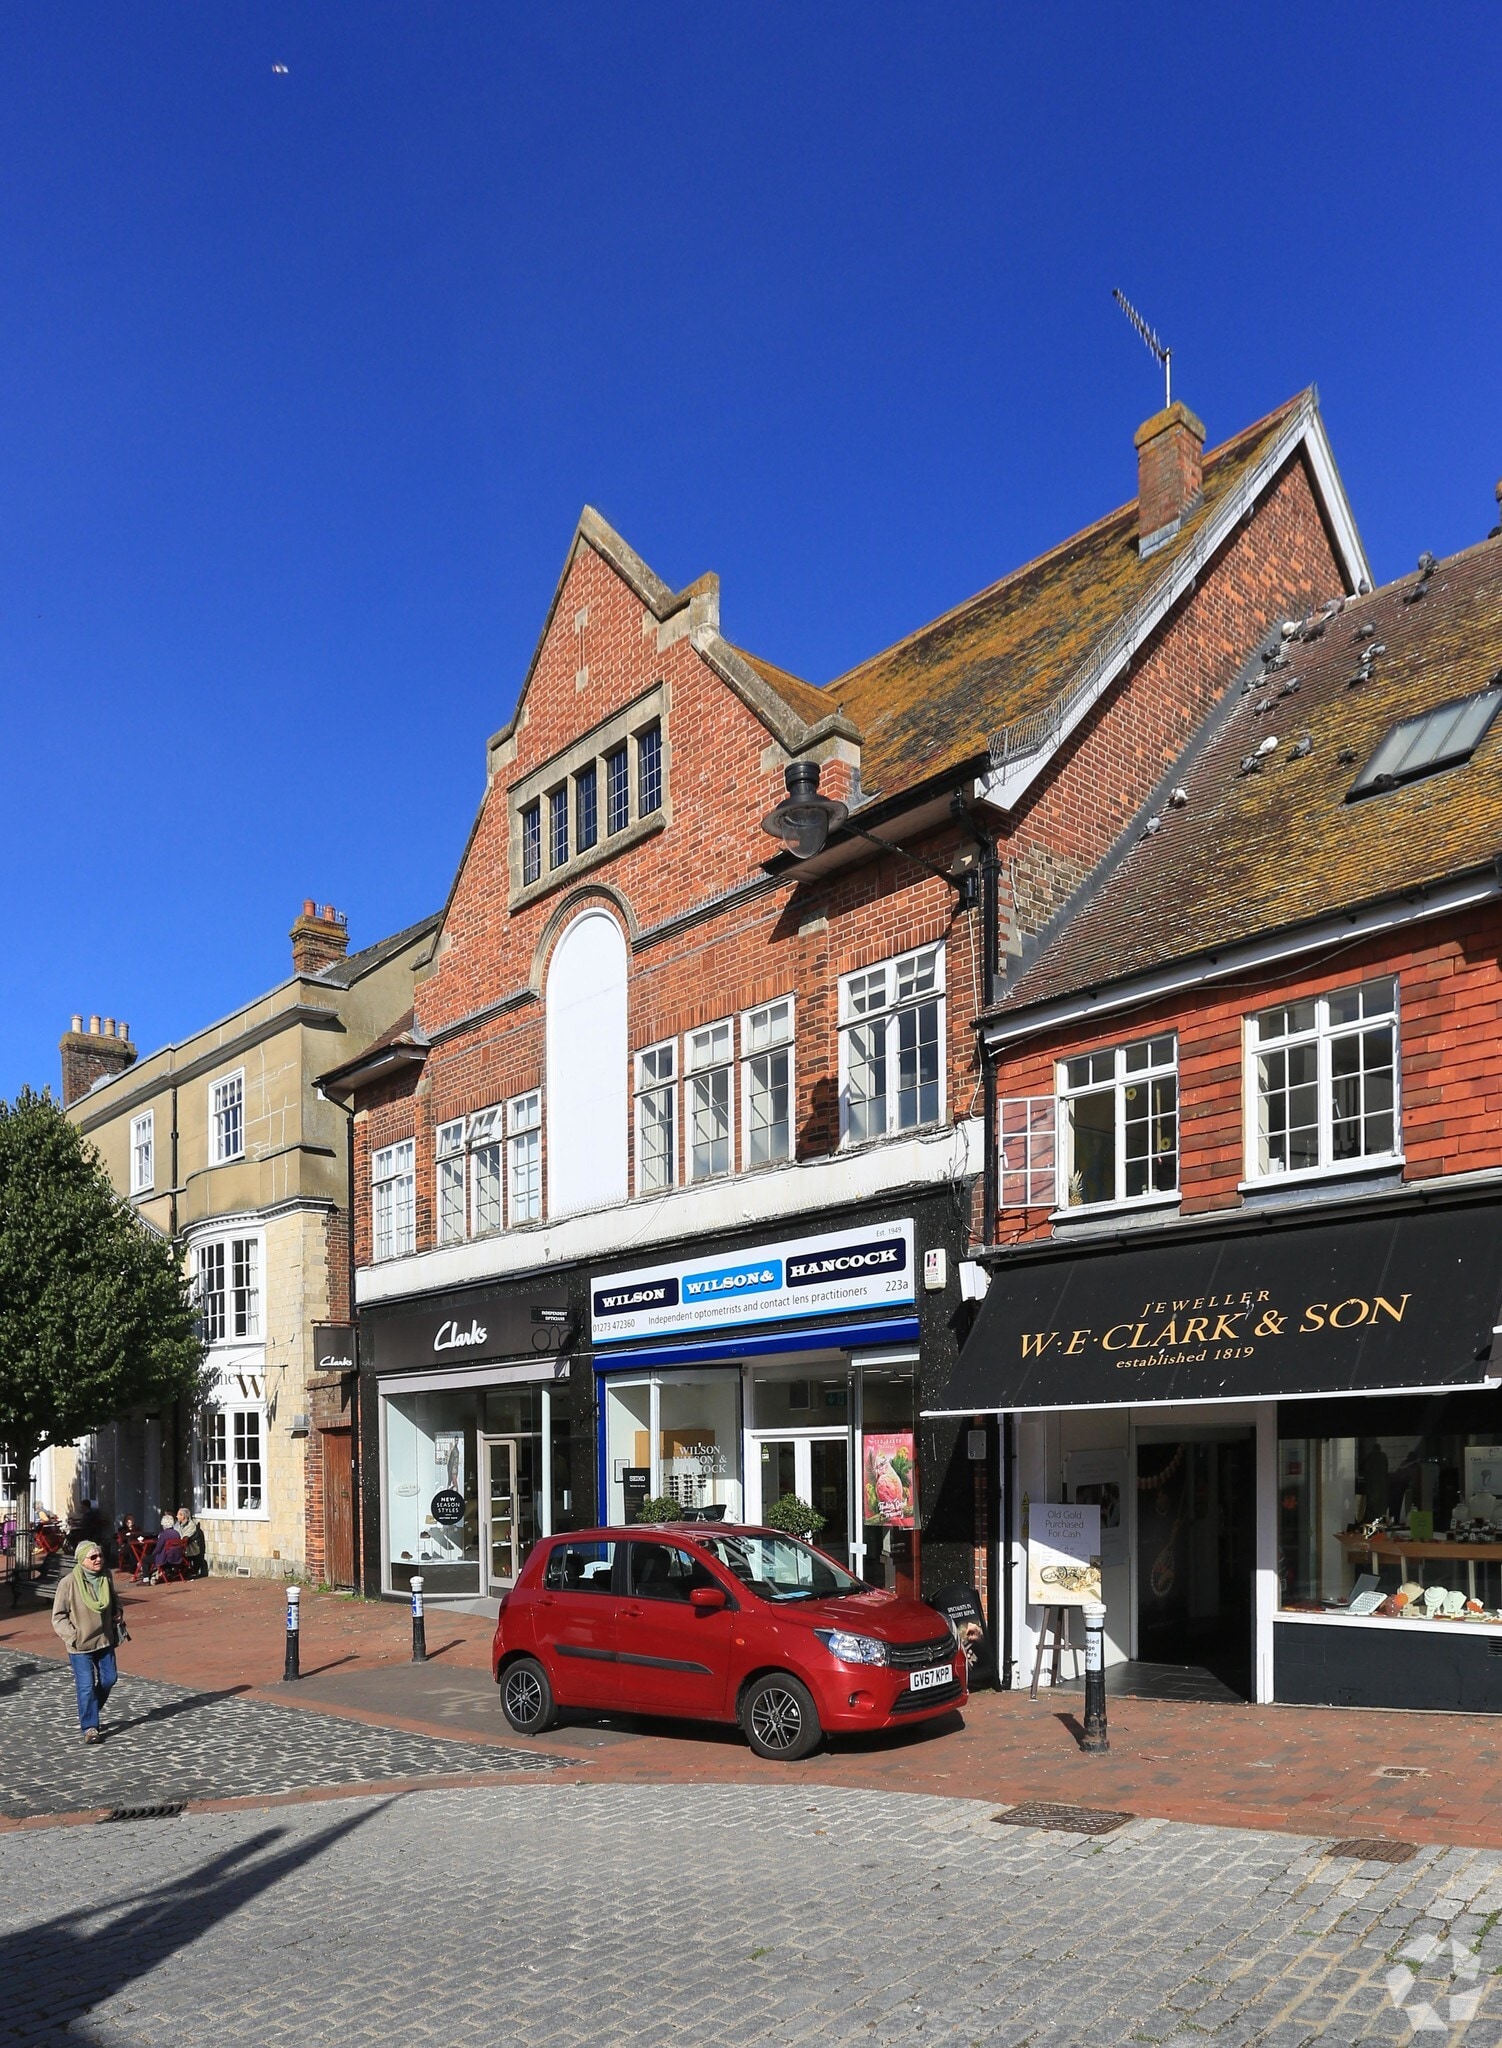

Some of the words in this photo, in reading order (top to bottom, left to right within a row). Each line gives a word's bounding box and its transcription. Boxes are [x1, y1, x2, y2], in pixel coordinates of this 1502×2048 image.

[876, 1229, 887, 1237] Est.
[888, 1226, 902, 1234] 1949
[602, 1288, 666, 1308] WILSON
[790, 1248, 898, 1278] HANCOCK
[886, 1280, 908, 1292] 223a
[648, 1311, 692, 1325] Independent
[694, 1305, 741, 1320] optometrists
[743, 1300, 758, 1312] and
[760, 1297, 790, 1309] contact
[792, 1294, 809, 1304] lens
[812, 1287, 868, 1304] practitioners
[1140, 1290, 1270, 1317] JEWELLER
[1254, 1310, 1288, 1336] &
[1299, 1294, 1412, 1333] SON
[592, 1322, 610, 1332] 01273
[612, 1319, 635, 1330] 472360
[434, 1319, 488, 1352] Clarks
[319, 1355, 353, 1367] Clarks
[1116, 1350, 1207, 1368] established
[1213, 1346, 1254, 1360] 1819
[680, 1446, 720, 1454] WILSON
[719, 1455, 727, 1464] &
[1048, 1510, 1061, 1518] Old
[1063, 1510, 1082, 1519] Gold
[1046, 1520, 1084, 1528] Purchased
[914, 1670, 935, 1687] GV67
[936, 1667, 949, 1684] KPP
